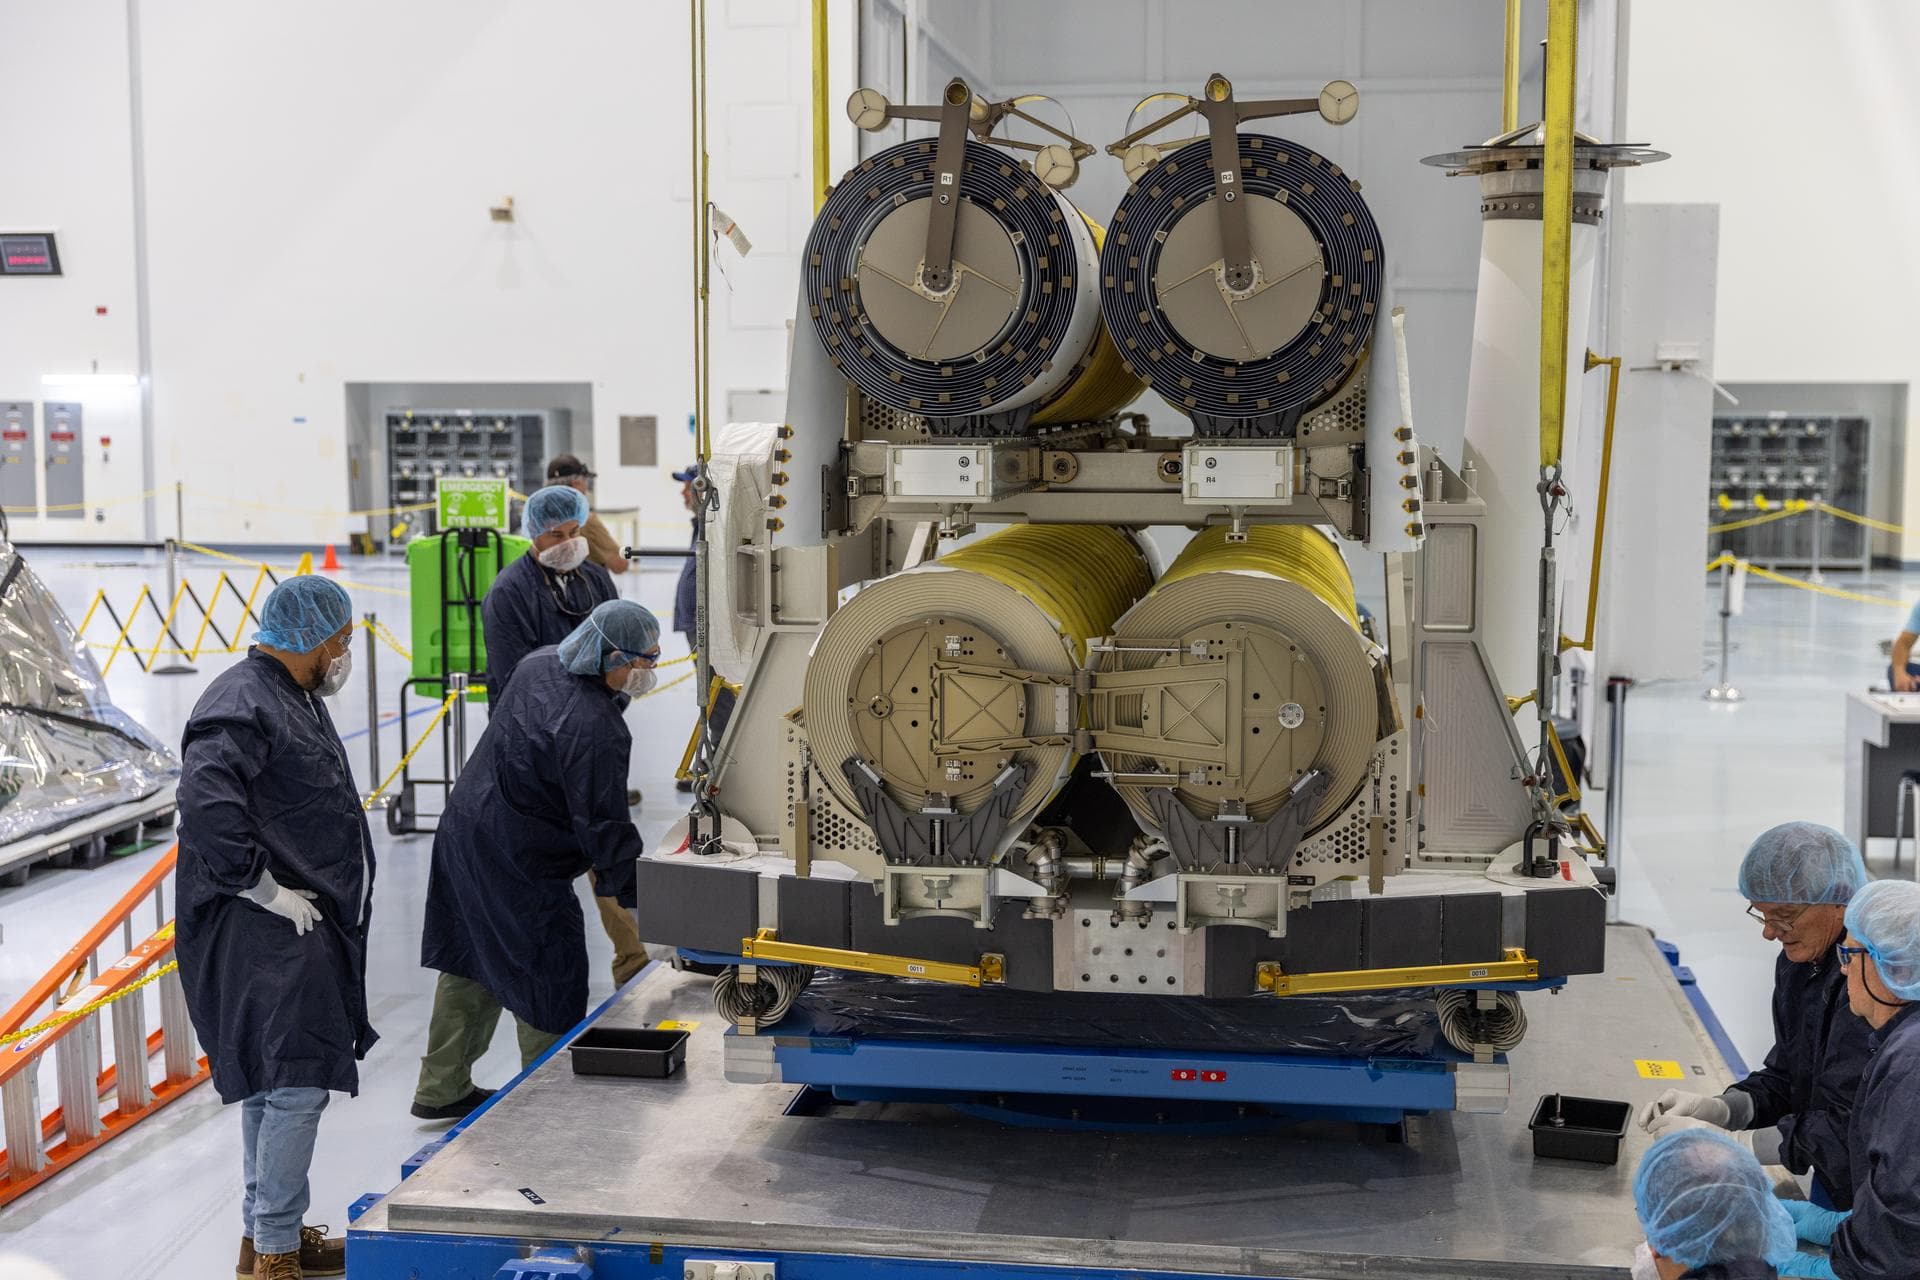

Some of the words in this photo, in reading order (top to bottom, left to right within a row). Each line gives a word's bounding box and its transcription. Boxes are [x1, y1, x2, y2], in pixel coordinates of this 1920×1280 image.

[442, 482, 503, 492] EMERGENCY
[447, 516, 466, 527] EYE
[469, 516, 498, 527] WASH
